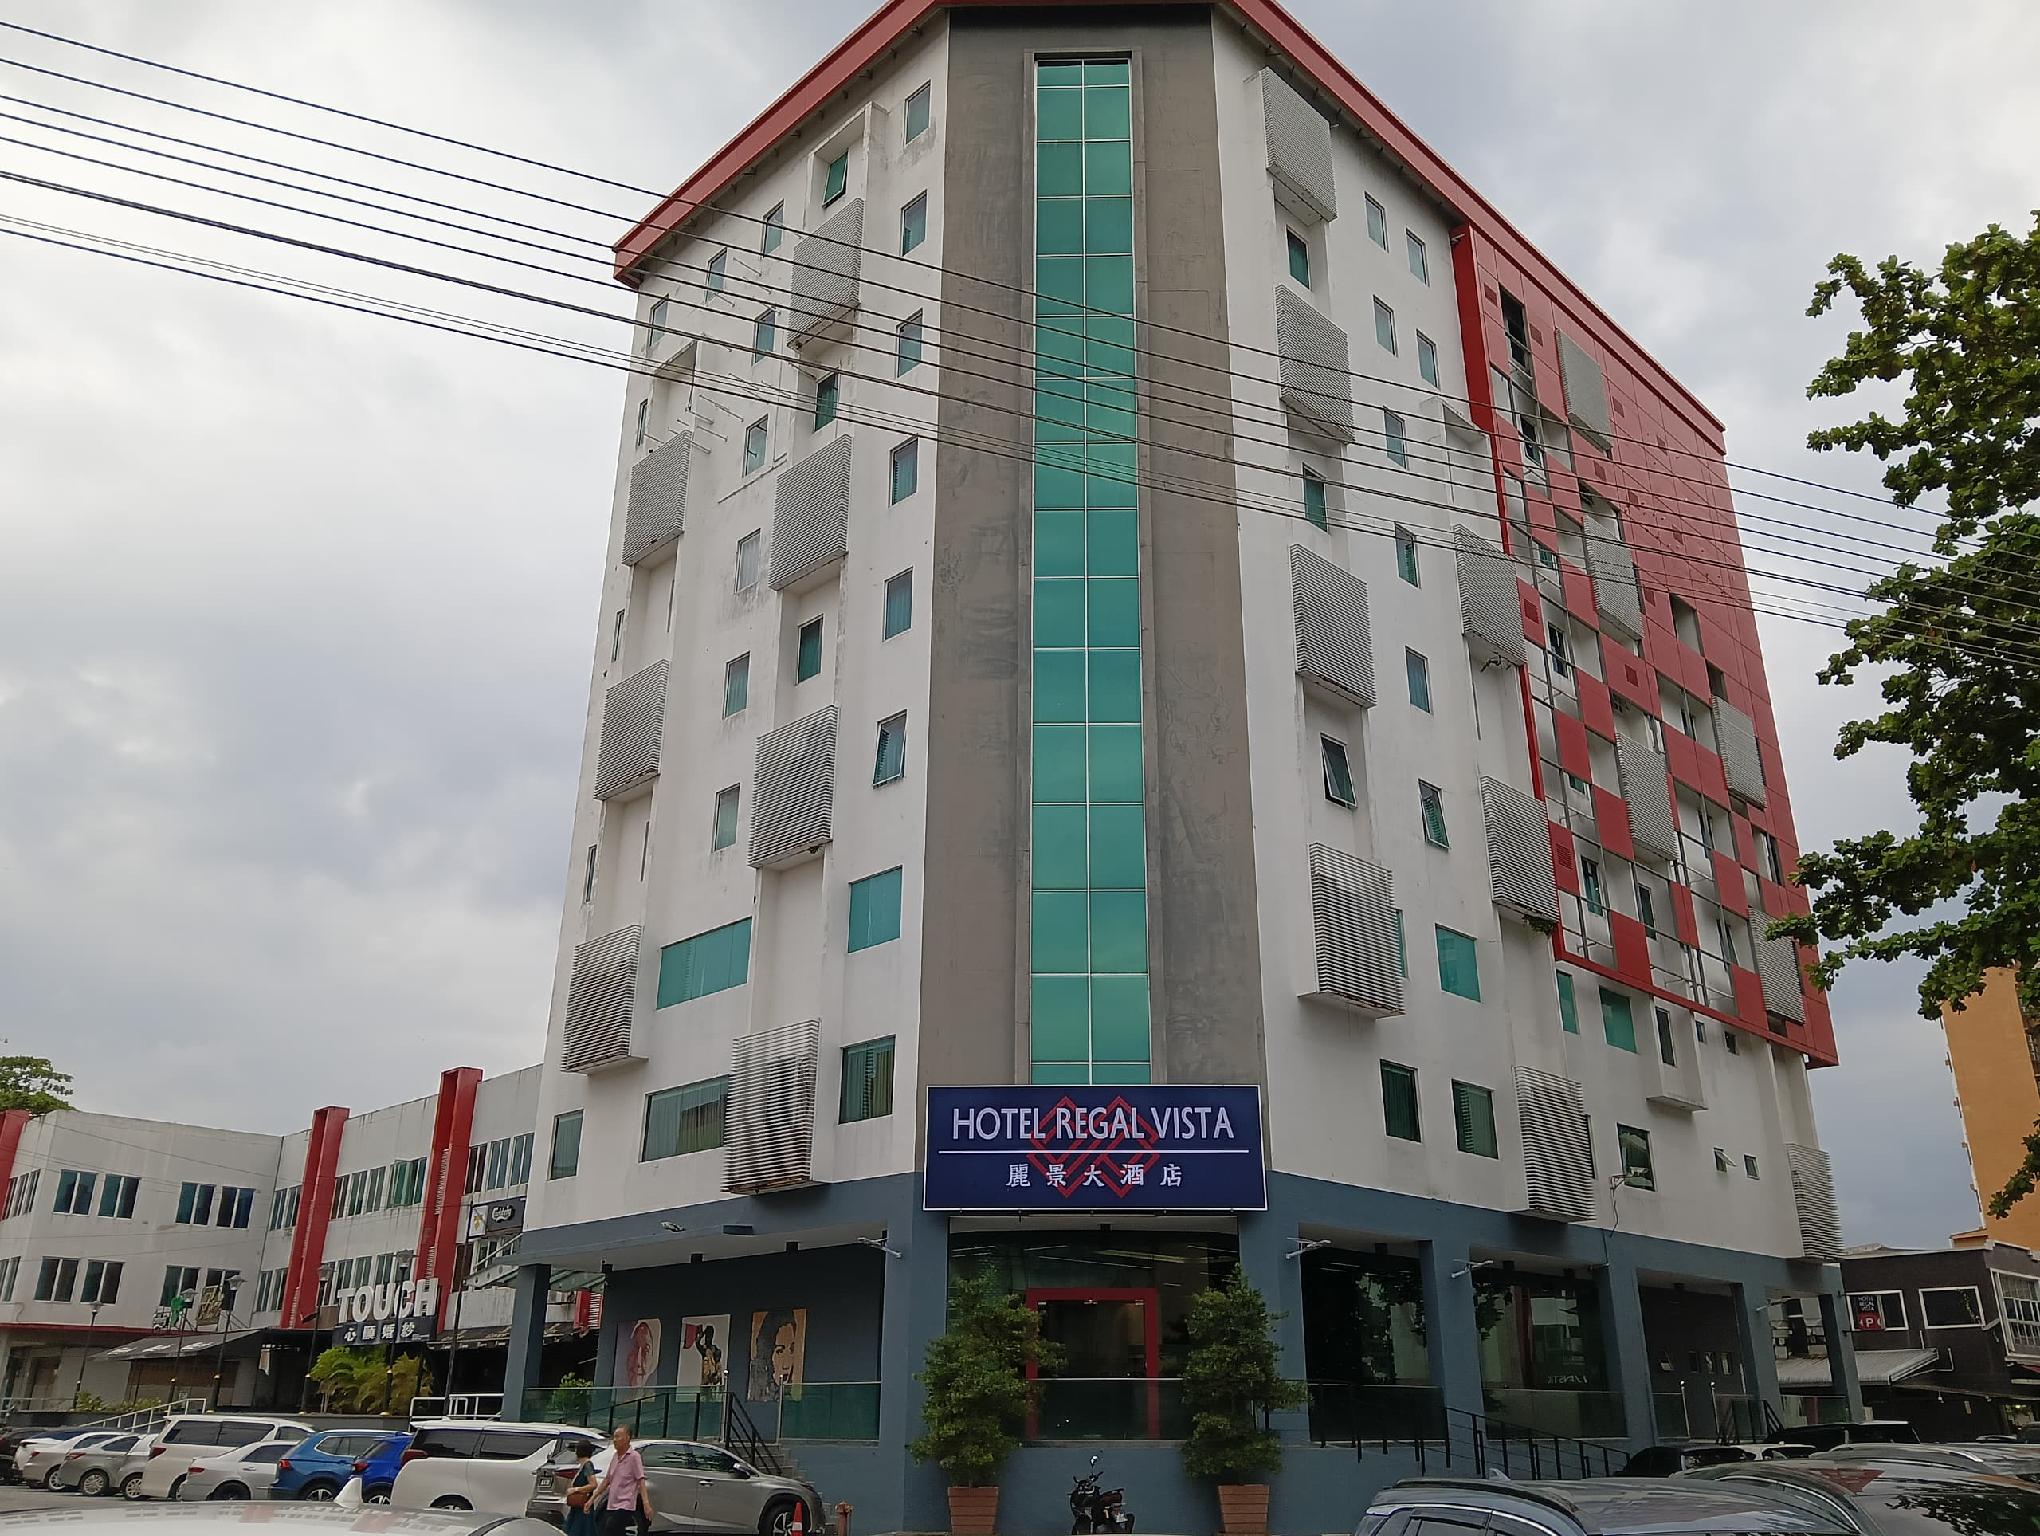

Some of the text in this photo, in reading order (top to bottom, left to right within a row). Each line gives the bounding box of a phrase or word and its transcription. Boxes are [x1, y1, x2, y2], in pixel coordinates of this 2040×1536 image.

[952, 1107, 1235, 1140] HOTEL REGAL VISTA
[1006, 1164, 1183, 1188] 麗景大酒店
[337, 1278, 439, 1324] TOUCH
